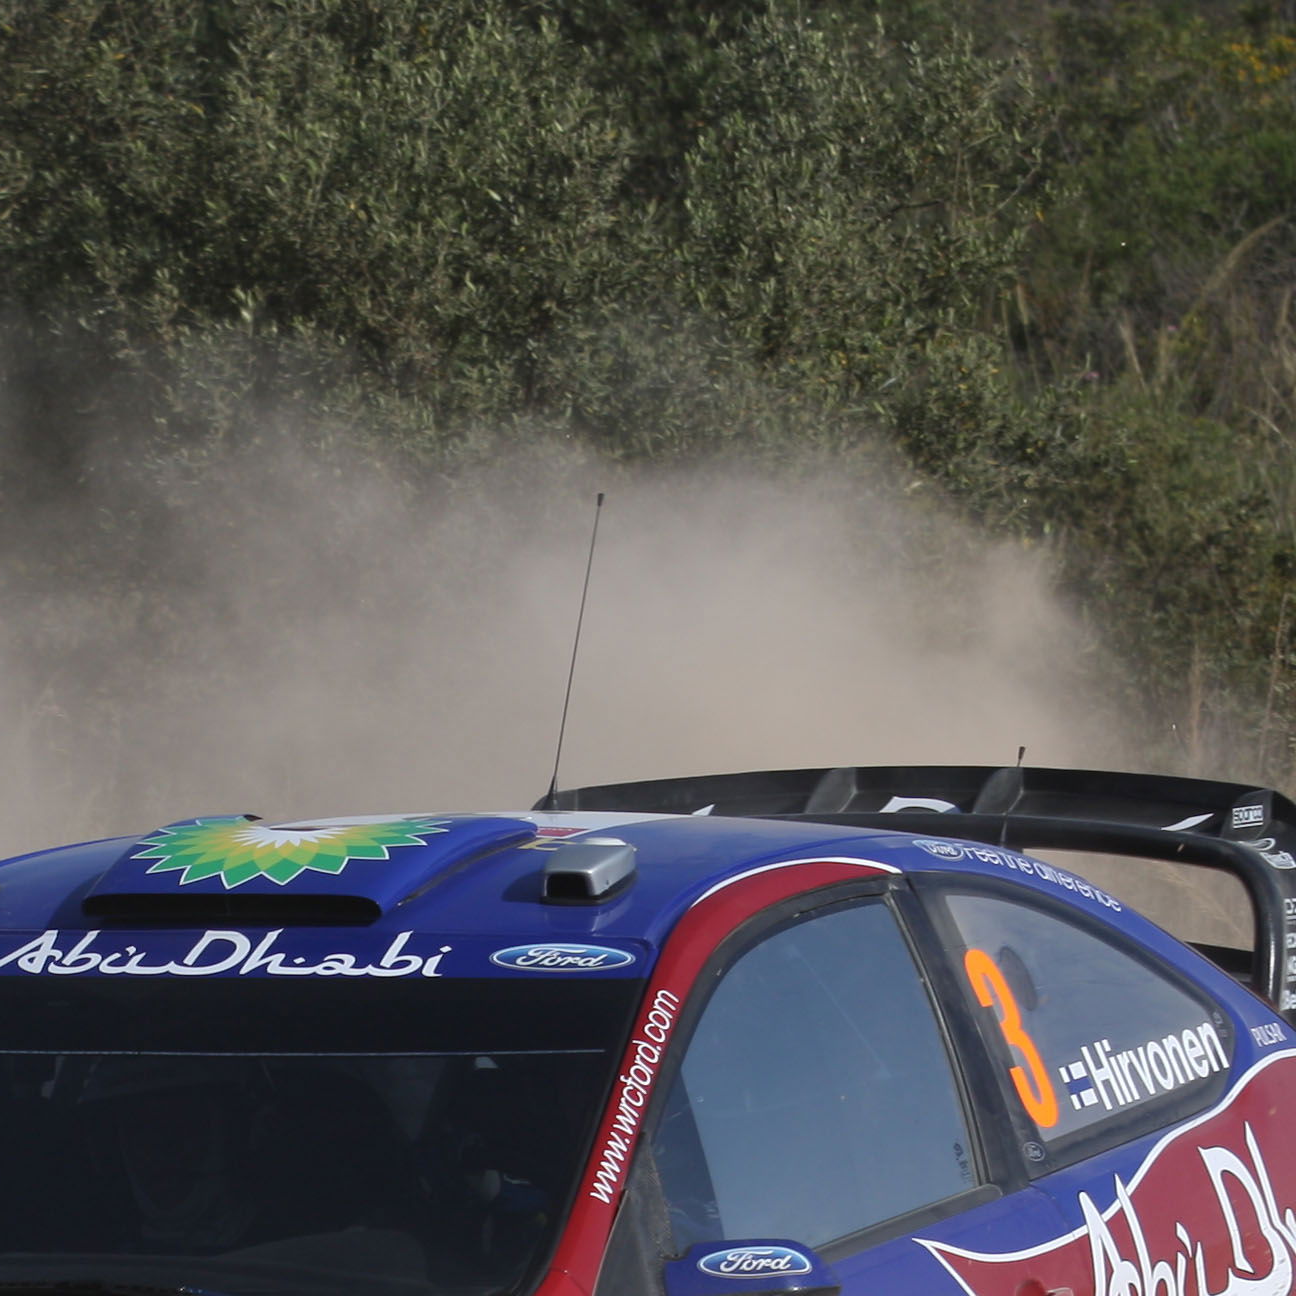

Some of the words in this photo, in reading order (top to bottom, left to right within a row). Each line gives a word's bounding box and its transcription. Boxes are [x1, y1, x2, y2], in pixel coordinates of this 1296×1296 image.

[182, 929, 452, 977] Dhabi
[964, 947, 1060, 1128] 3
[1080, 1020, 1230, 1111] Hirvonen
[590, 988, 680, 1205] www.wrcford.com
[719, 1250, 792, 1272] Ford
